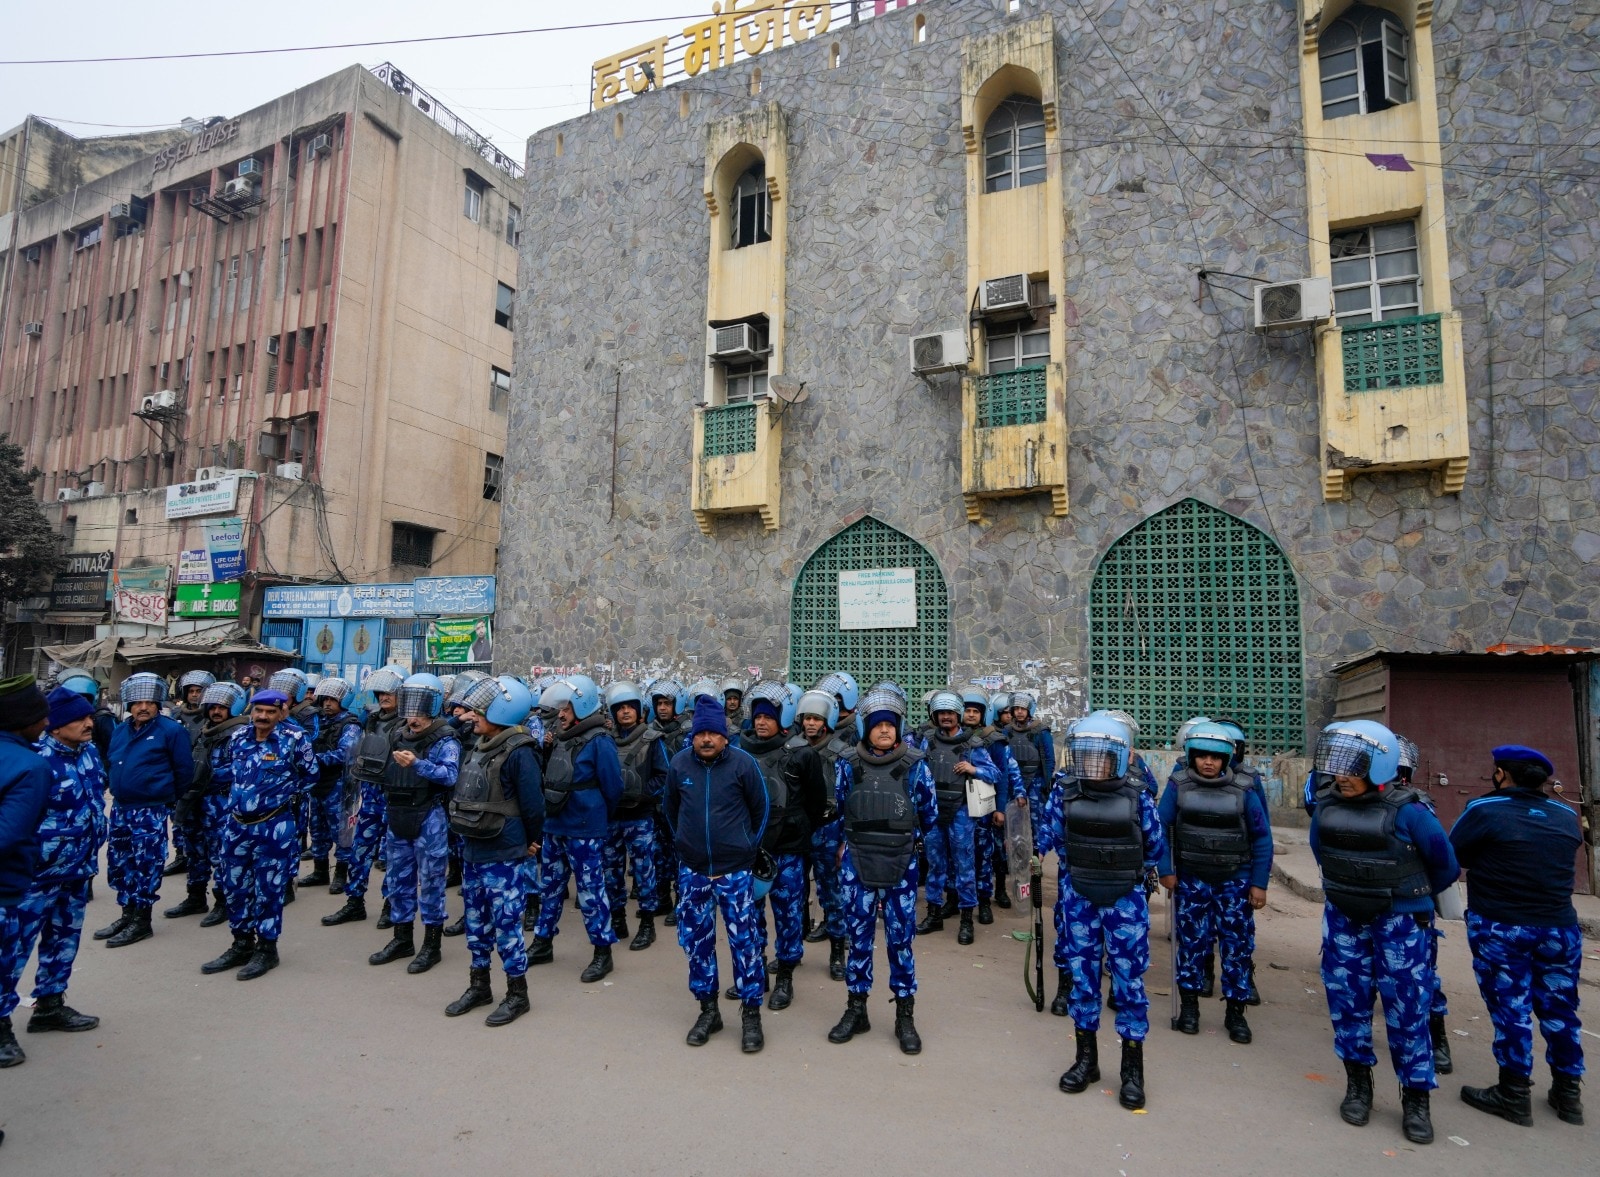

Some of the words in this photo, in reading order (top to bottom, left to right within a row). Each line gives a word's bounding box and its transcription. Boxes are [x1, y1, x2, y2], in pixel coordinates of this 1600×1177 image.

[195, 118, 241, 157] HOUSE
[168, 496, 195, 507] HEALTHCARE
[195, 494, 213, 503] PRIVATE
[213, 491, 231, 501] LIMITED
[210, 532, 240, 541] Leeford
[73, 582, 83, 591] AND
[84, 581, 105, 590] GERMAN
[56, 595, 71, 604] SILVER
[72, 594, 98, 604] JEWELLERY
[119, 591, 167, 610] PHOTO
[281, 591, 295, 601] STATE
[295, 591, 307, 601] HAJ
[307, 590, 337, 601] COMMITTEE
[119, 607, 162, 622] COPY
